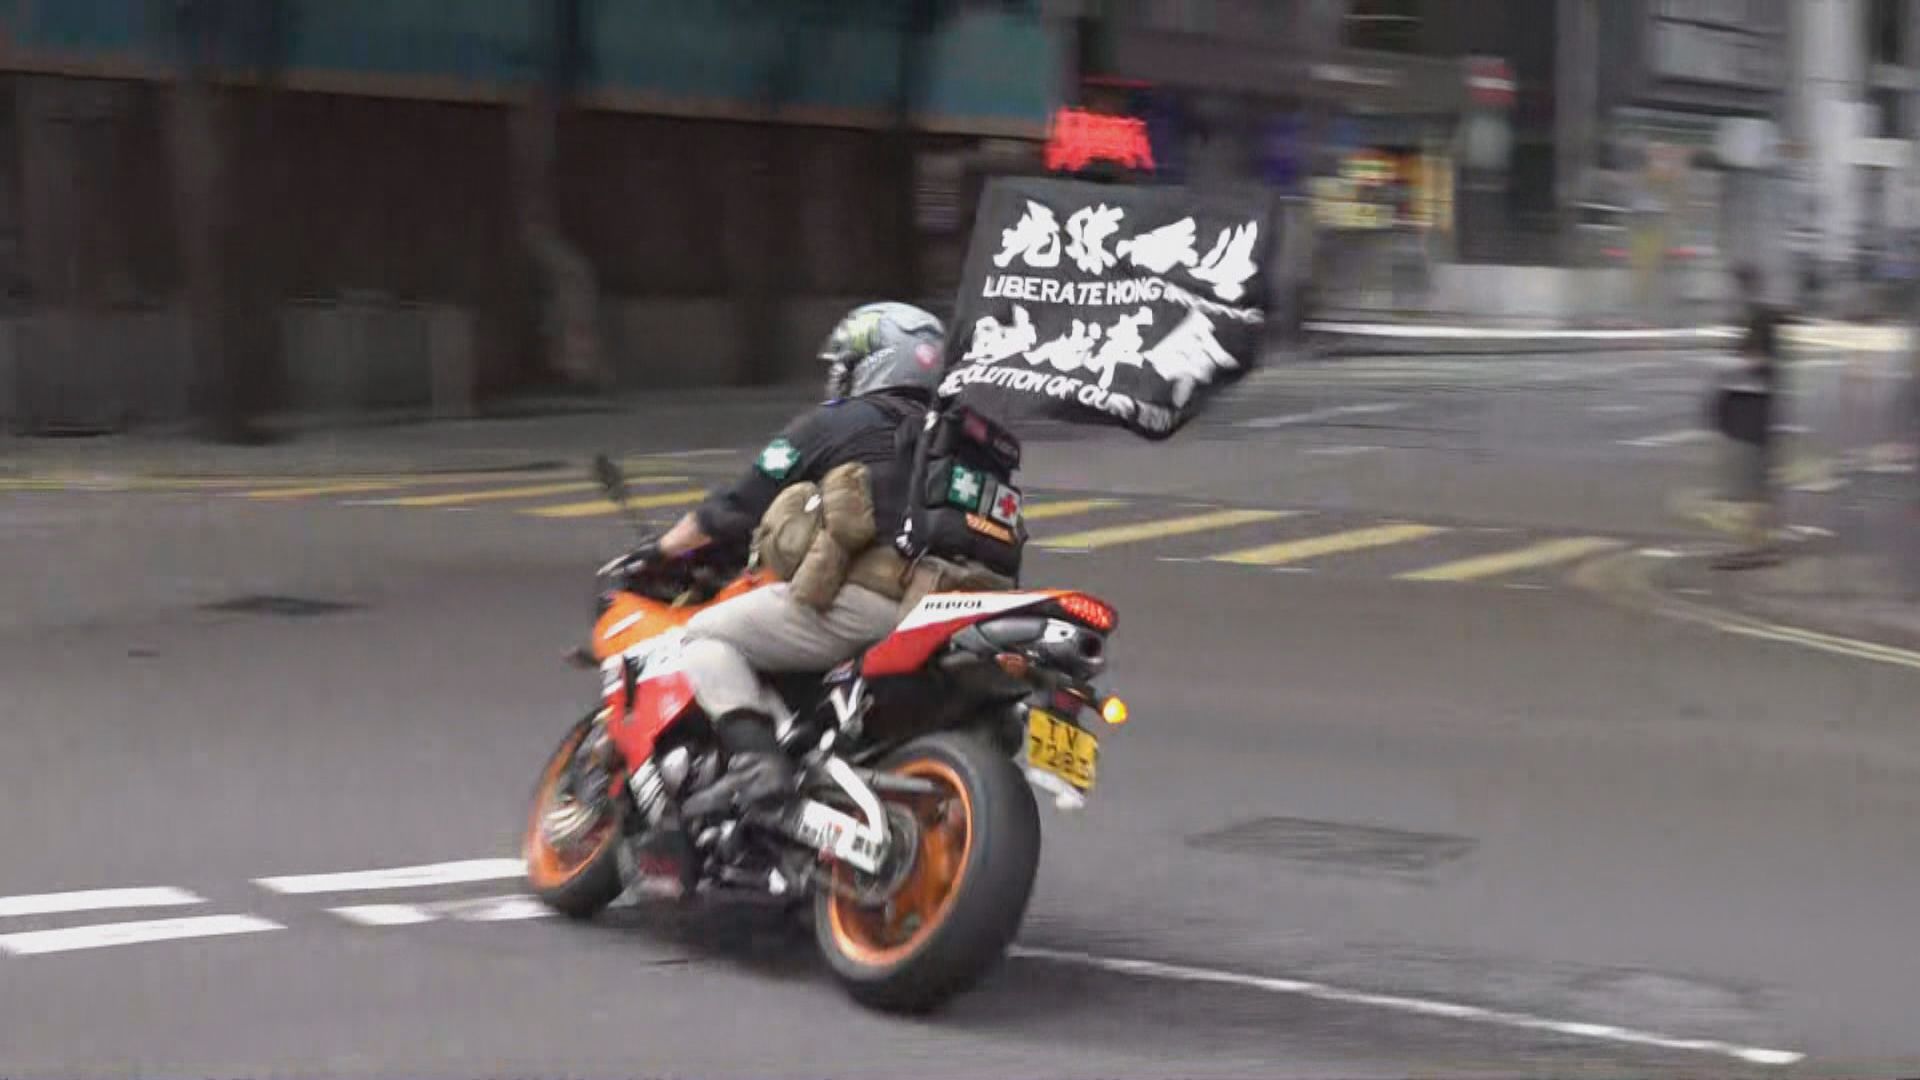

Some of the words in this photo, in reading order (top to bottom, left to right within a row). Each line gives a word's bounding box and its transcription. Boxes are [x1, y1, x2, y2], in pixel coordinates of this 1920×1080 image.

[983, 274, 1102, 305] LIBERATE
[1106, 276, 1168, 304] HONG
[937, 363, 1051, 397] EOLUTION
[1046, 375, 1082, 400] OF
[1046, 717, 1079, 751] TV
